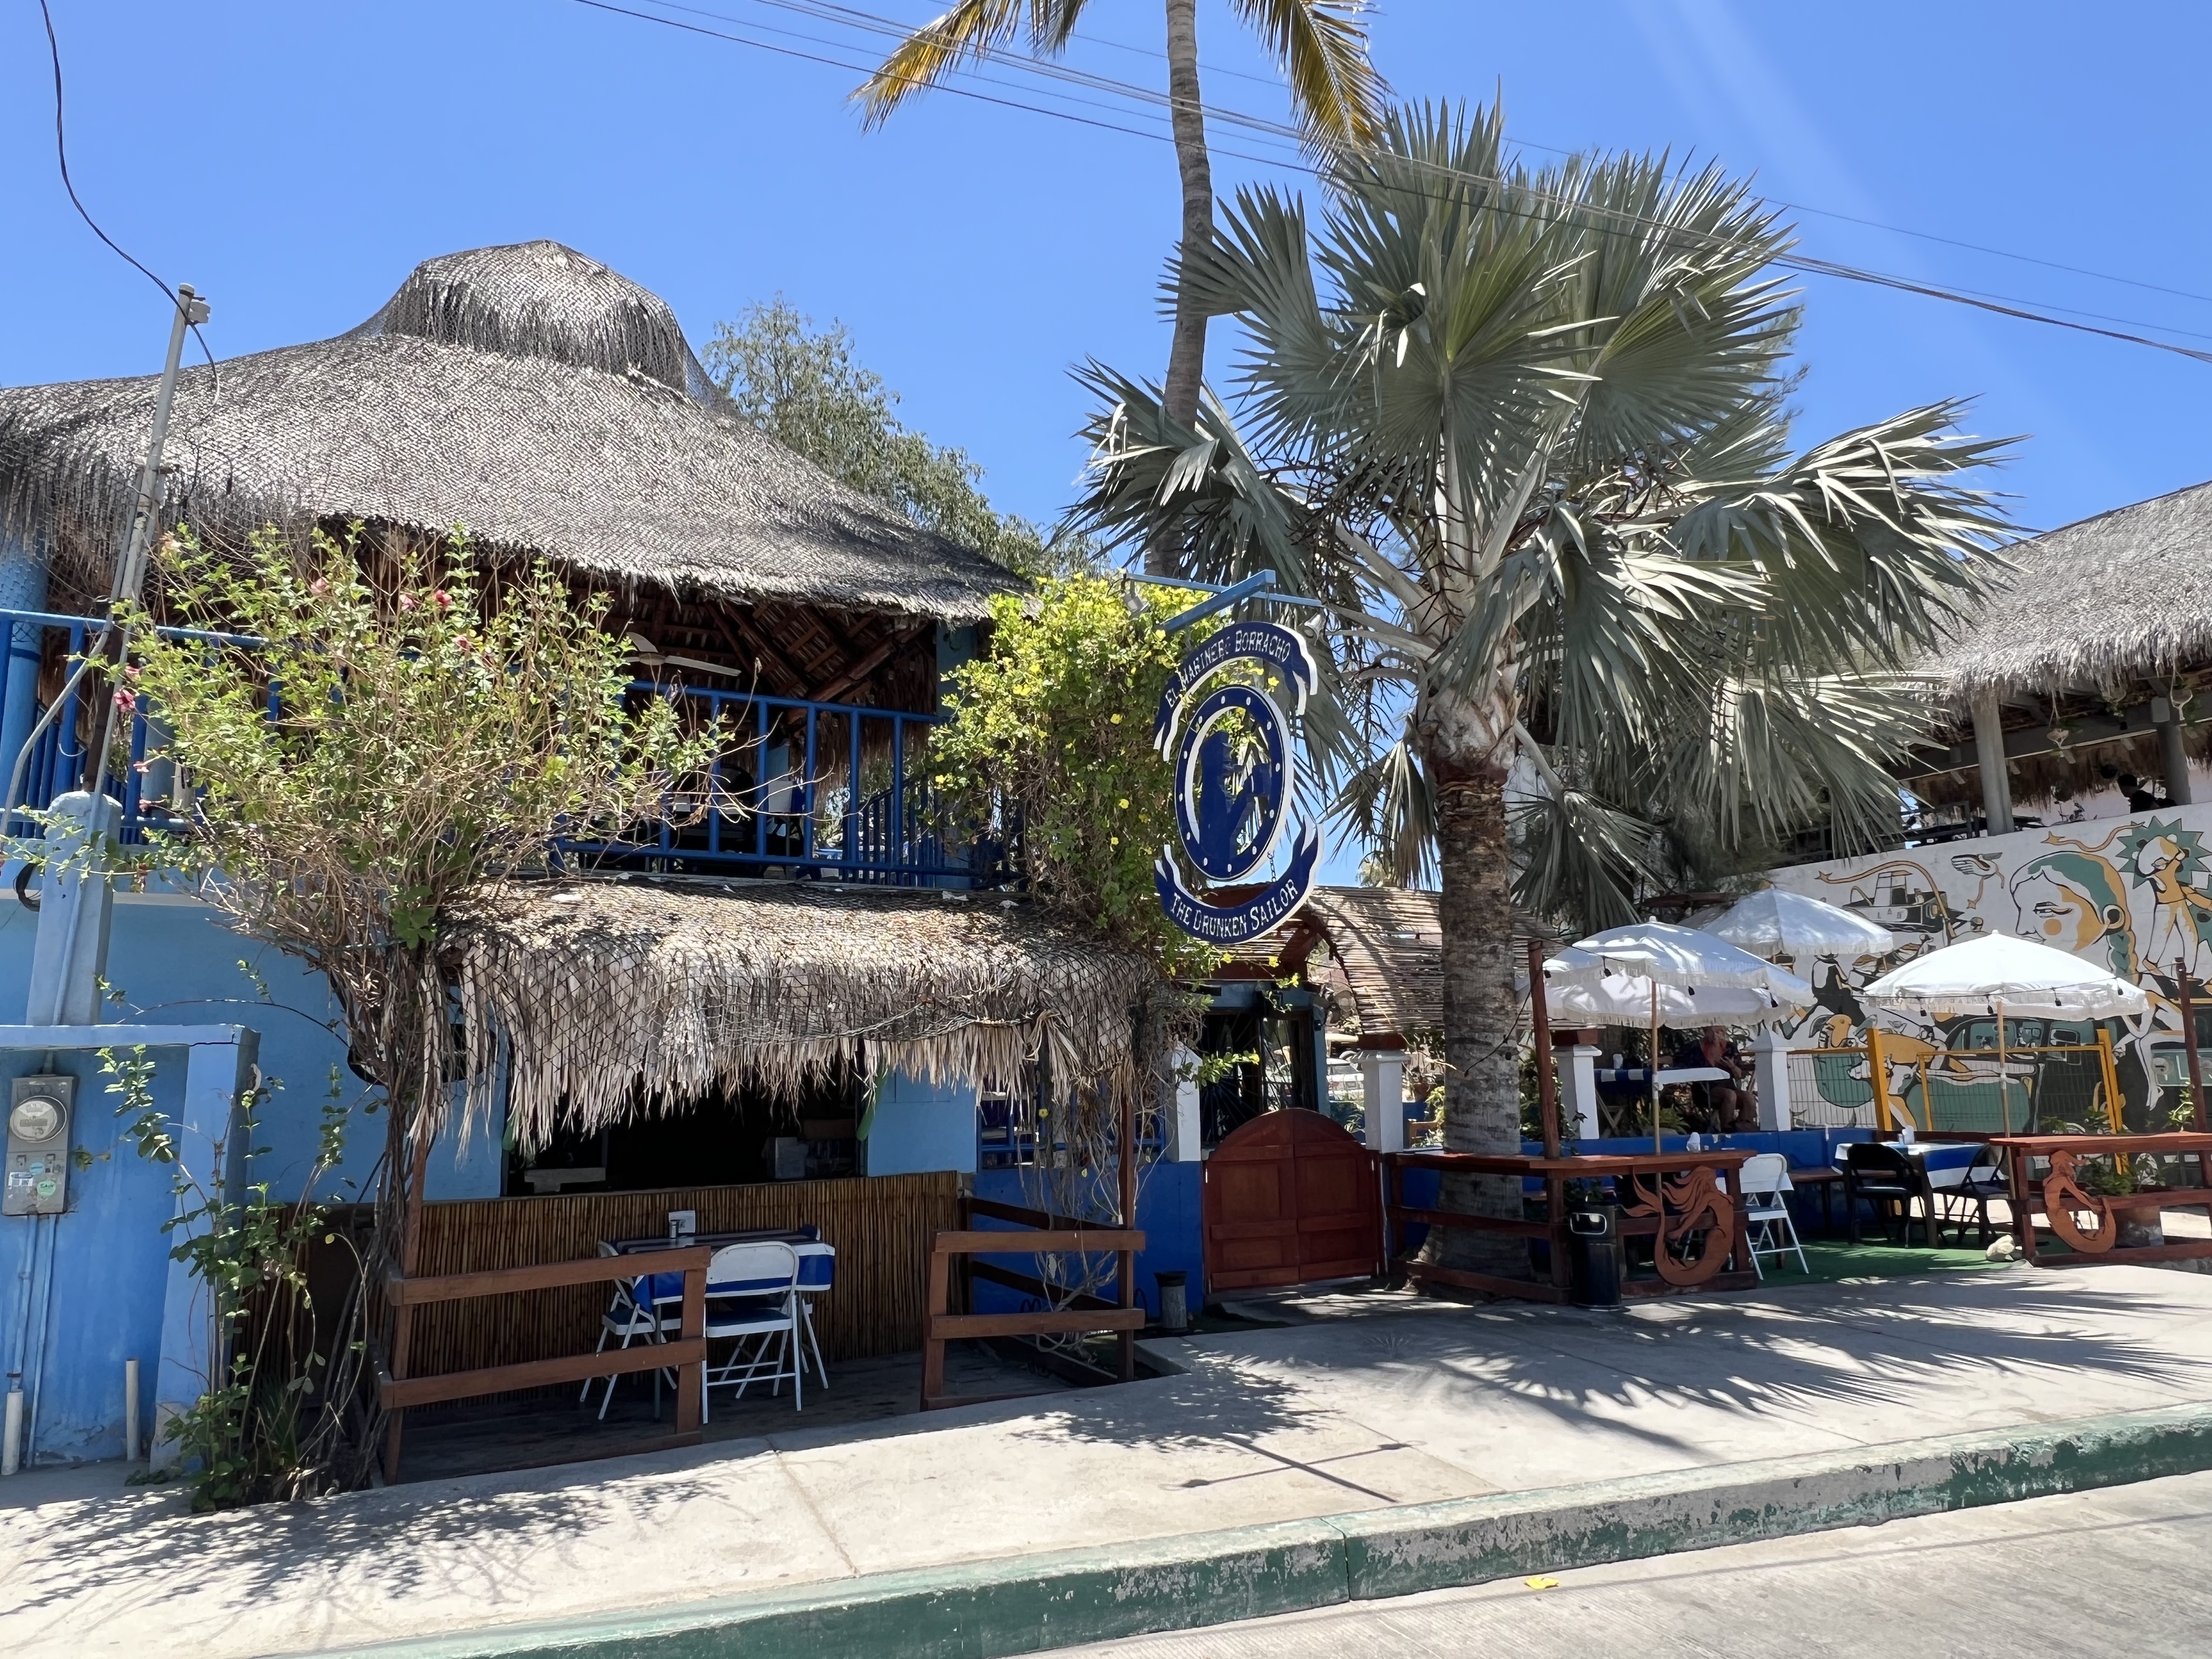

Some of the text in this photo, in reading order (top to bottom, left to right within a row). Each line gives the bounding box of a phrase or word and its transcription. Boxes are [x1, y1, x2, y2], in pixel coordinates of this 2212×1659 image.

[1165, 687, 1179, 708] EL
[1235, 630, 1291, 662] BORRACHO
[1170, 879, 1298, 939] THE DRUNKEN SAILOR
